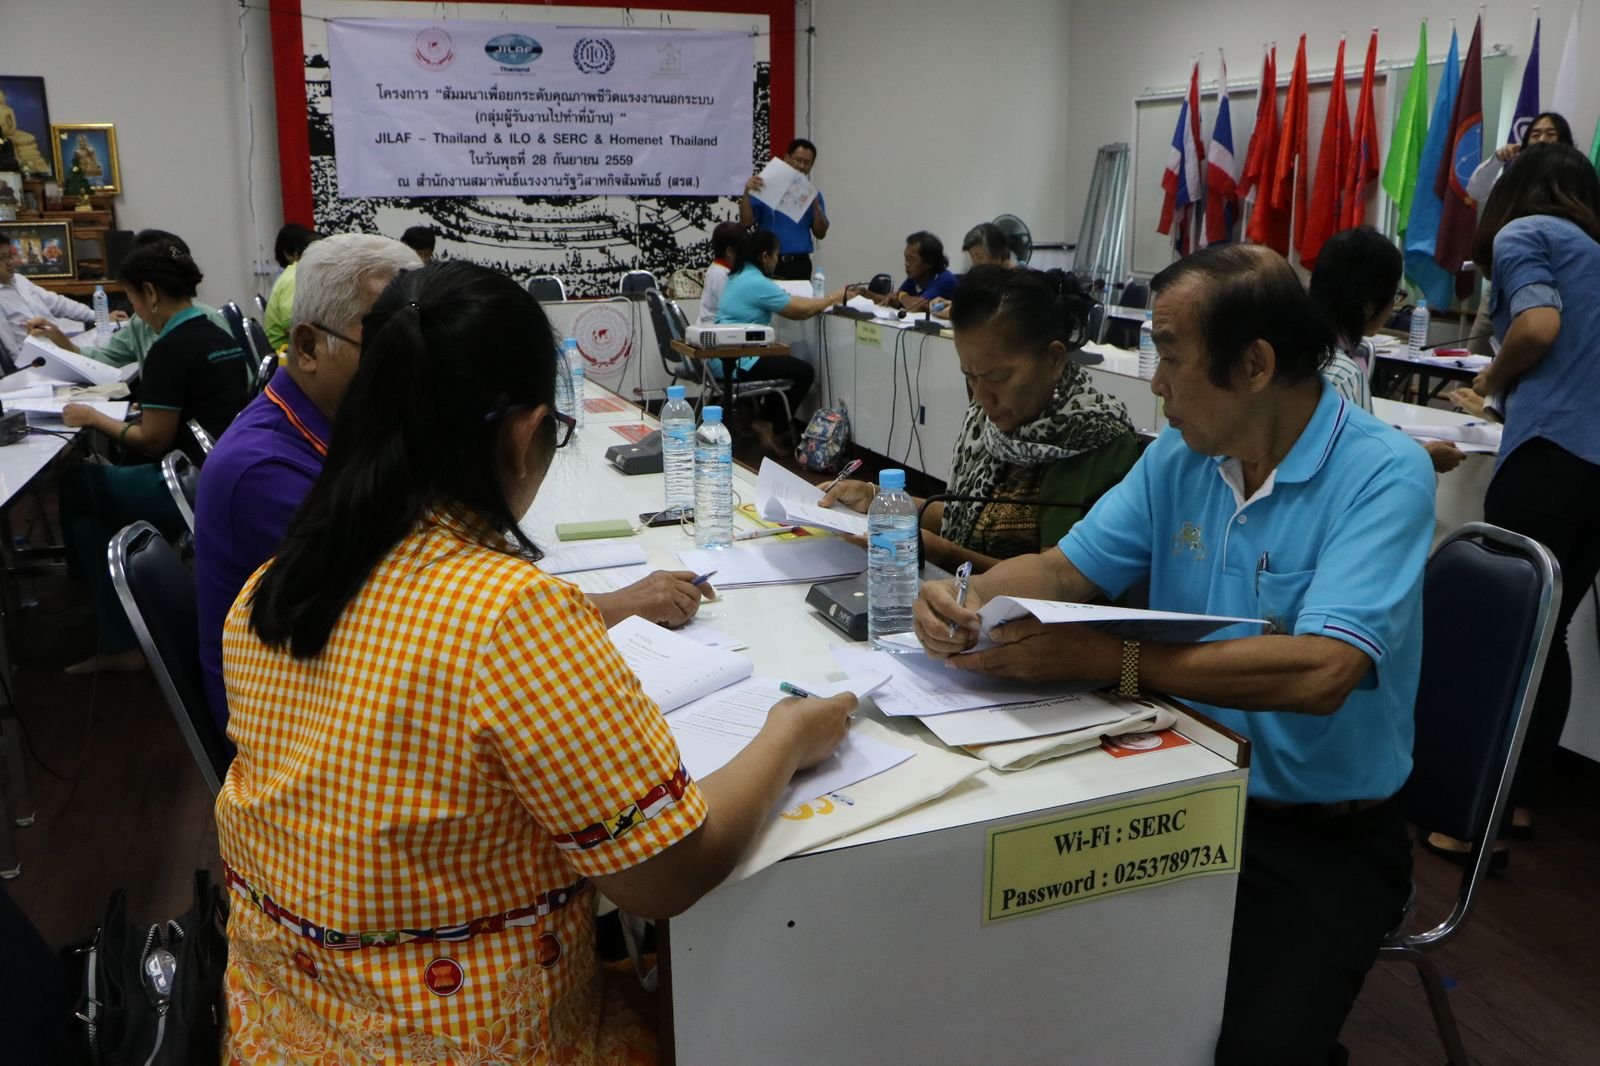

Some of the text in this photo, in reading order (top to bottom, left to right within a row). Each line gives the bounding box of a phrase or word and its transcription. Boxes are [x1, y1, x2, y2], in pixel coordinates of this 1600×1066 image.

[376, 83, 429, 100] โครงการ
[375, 132, 412, 144] JILAF
[433, 132, 487, 144] Thailand
[494, 133, 503, 144] &
[509, 133, 531, 144] ILO
[537, 133, 547, 144] &
[553, 133, 588, 144] SERC
[594, 134, 603, 144] &
[610, 134, 663, 145] Homenet
[669, 134, 718, 146] Thailand
[469, 149, 633, 169] ในวันพุธที่ 28 กันยายน 2559
[398, 179, 410, 187] ณ
[1054, 825, 1110, 856] Wi-Fi
[1128, 809, 1187, 841] SERC
[1001, 870, 1096, 911] Password
[1114, 844, 1228, 885] 025378973A
